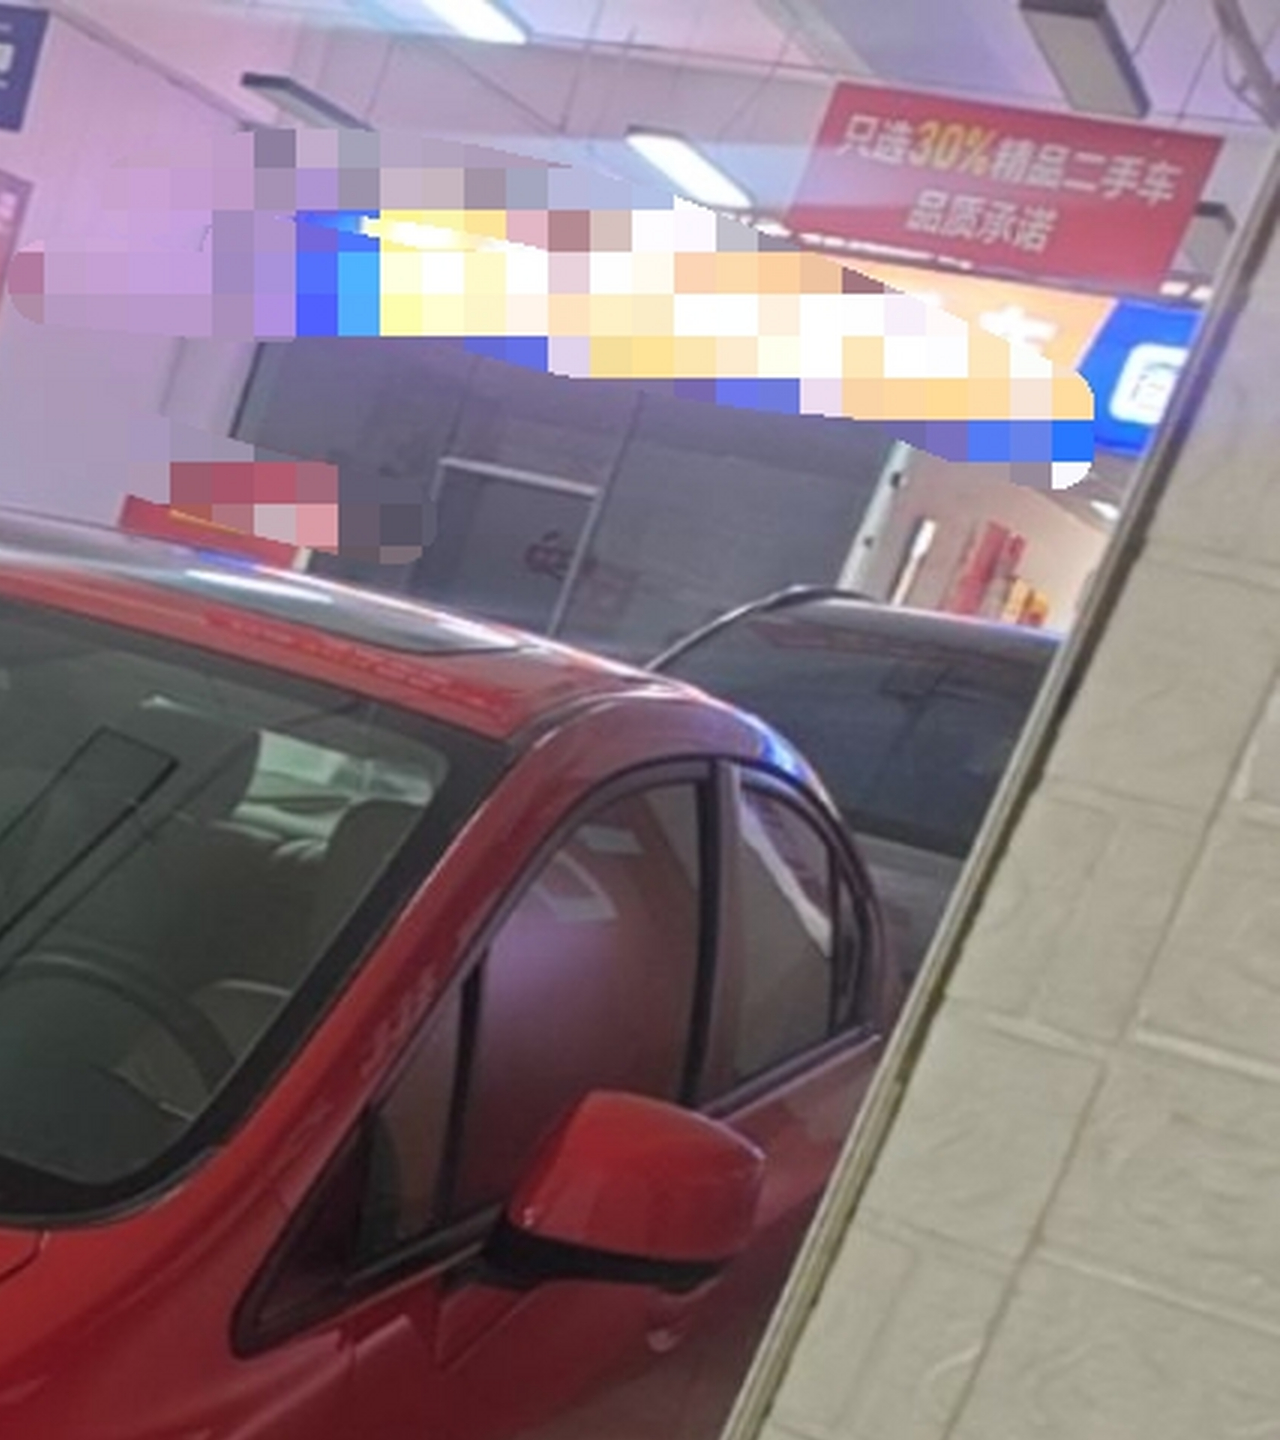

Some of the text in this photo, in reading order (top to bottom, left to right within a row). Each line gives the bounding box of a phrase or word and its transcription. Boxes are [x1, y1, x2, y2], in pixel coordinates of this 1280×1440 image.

[840, 114, 1183, 205] 只选30%精品二手车
[906, 189, 1057, 253] 品质承诺
